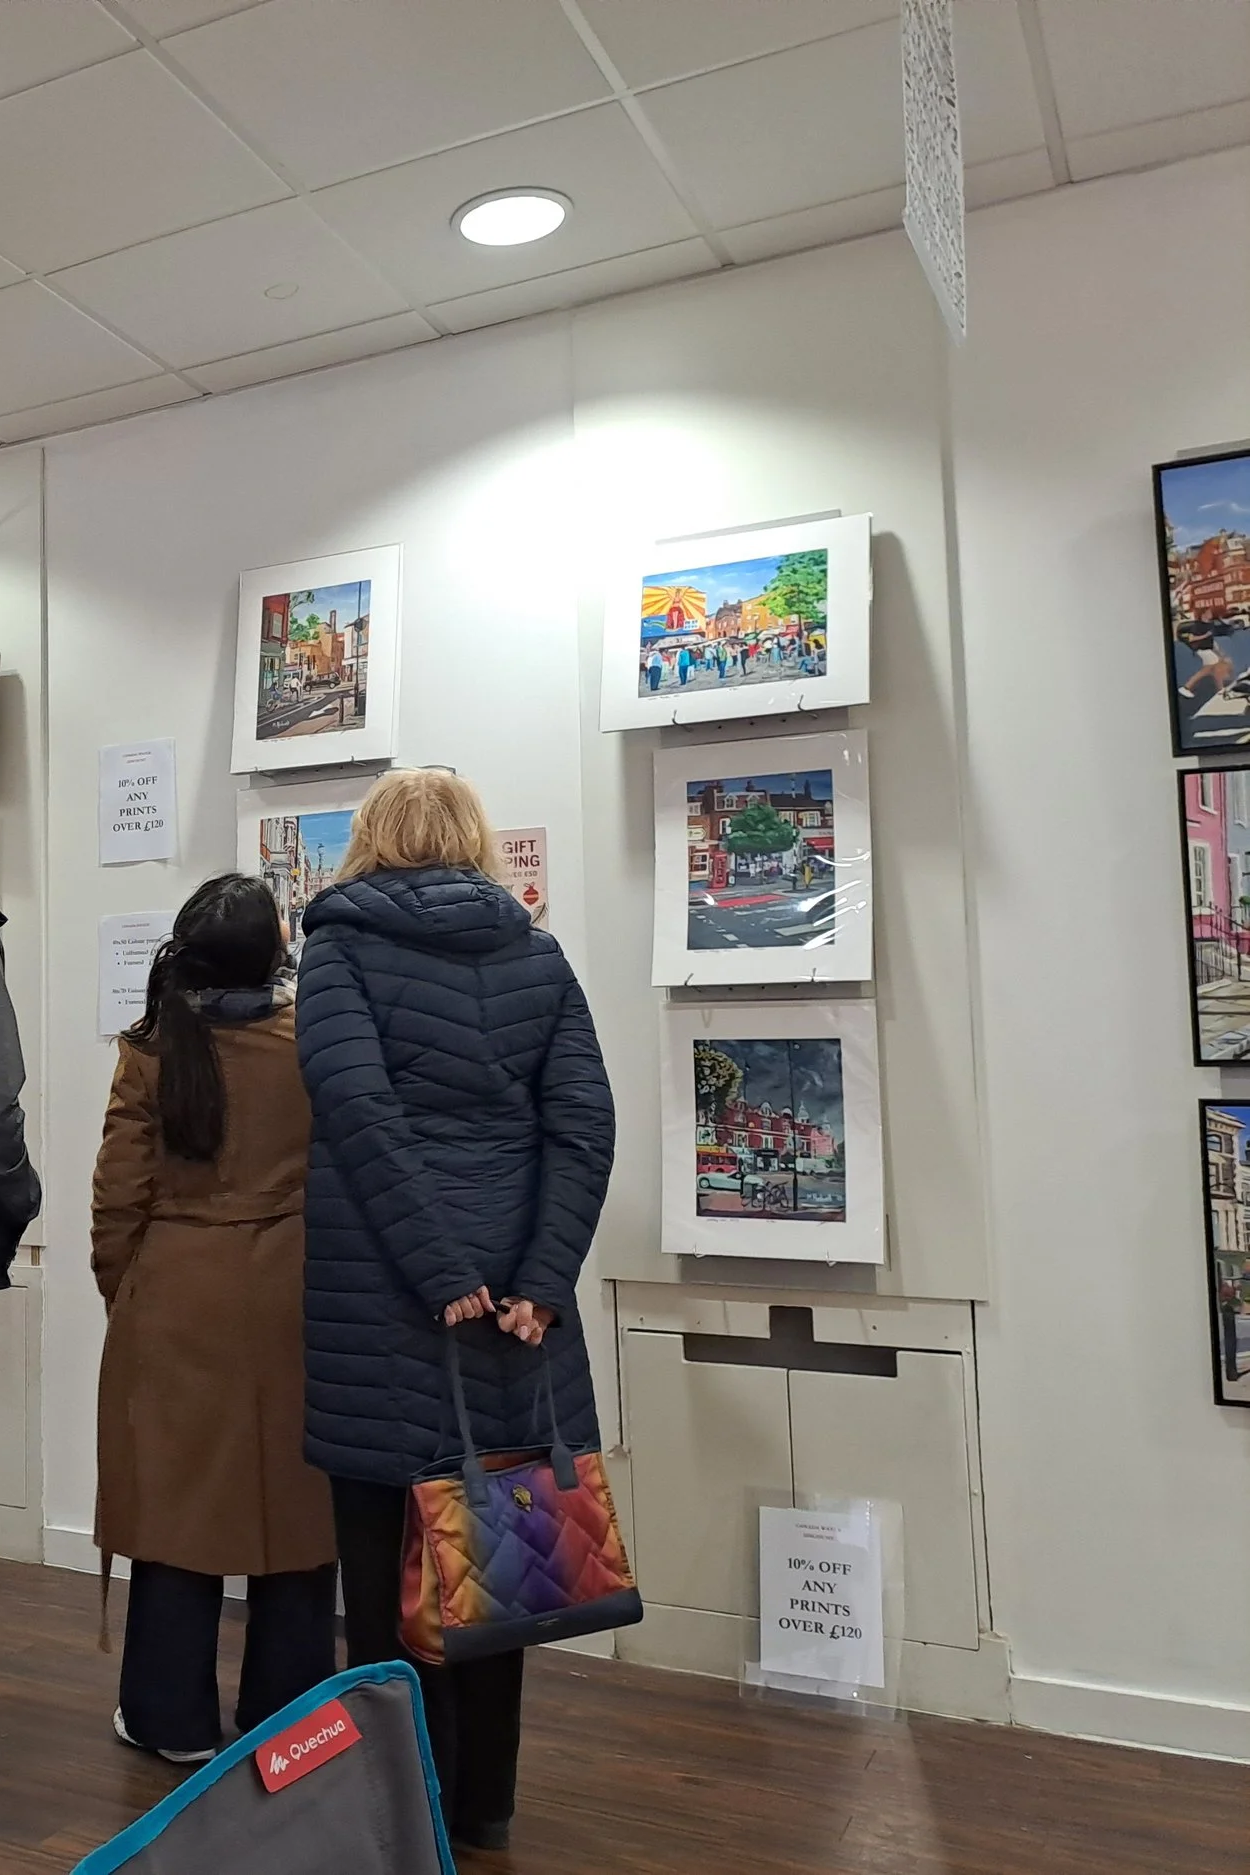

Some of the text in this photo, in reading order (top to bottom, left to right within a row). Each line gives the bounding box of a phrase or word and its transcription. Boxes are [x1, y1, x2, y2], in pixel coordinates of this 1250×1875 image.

[118, 776, 158, 788] 10% OFF
[126, 791, 149, 802] ANY
[119, 805, 157, 817] PRINTS
[112, 819, 164, 832] OVER £120
[502, 839, 537, 854] GIFT
[787, 1557, 852, 1576] 10% OFF
[801, 1580, 838, 1594] ANY
[789, 1598, 851, 1617] PRINTS
[778, 1617, 863, 1640] OVER £120
[289, 1719, 346, 1761] Quechua
